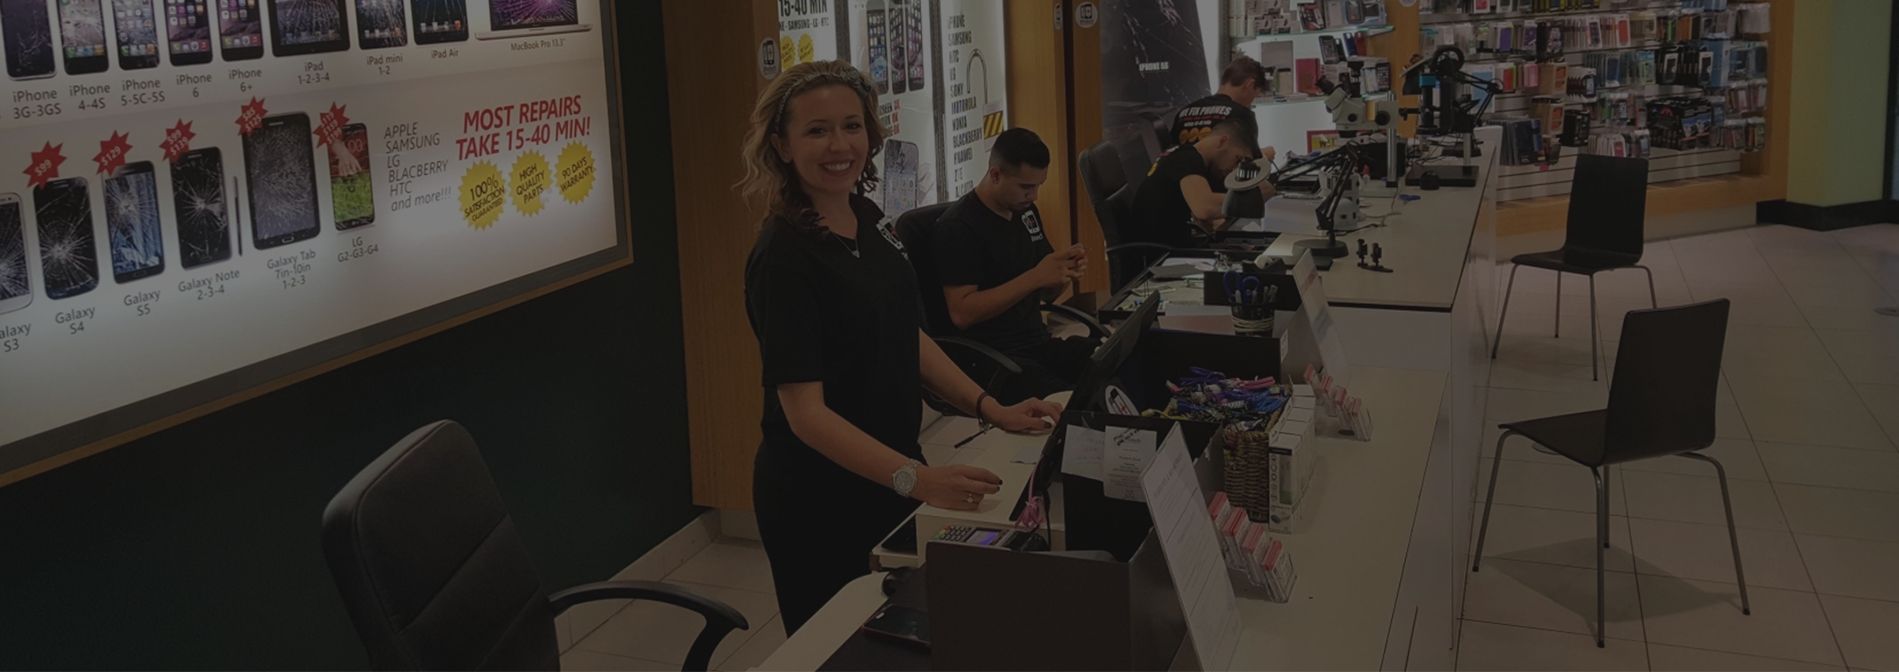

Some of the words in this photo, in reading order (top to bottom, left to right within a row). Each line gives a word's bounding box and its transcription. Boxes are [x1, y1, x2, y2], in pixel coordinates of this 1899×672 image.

[511, 40, 538, 51] MacBook
[540, 39, 551, 49] Pro
[366, 55, 385, 66] iPad
[386, 53, 403, 65] mini
[431, 50, 447, 60] iPad
[448, 49, 459, 59] Air
[228, 68, 262, 80] iPhone
[305, 60, 324, 73] iPad
[378, 65, 391, 76] 1-2
[122, 78, 161, 91] iPhone
[176, 73, 212, 86] iPhone
[297, 72, 330, 84] 1-2-3-4
[69, 82, 111, 97] iPhone
[193, 86, 200, 98] 6
[240, 81, 253, 93] 6+
[12, 89, 57, 103] iPhone
[78, 98, 106, 111] 4-4S
[121, 91, 165, 106] 5-5C-5S
[13, 102, 62, 119] 3G-3GS
[464, 105, 515, 133] MOST
[519, 94, 582, 124] REPAIRS
[384, 122, 418, 139] APPLE
[456, 131, 501, 161] TAKE
[506, 124, 550, 152] 15-40
[555, 116, 591, 143] MIN!
[386, 132, 441, 154] SAMSUNG
[101, 145, 121, 166] $129
[387, 154, 400, 169] LG
[34, 159, 52, 178] $99
[388, 160, 449, 183] BLACBERRY
[519, 163, 537, 181] HIGH
[573, 157, 588, 174] DAYS
[515, 171, 545, 196] QUALITY
[560, 164, 594, 193] WARRANTY
[390, 180, 412, 197] HTC
[469, 174, 499, 201] 100%
[523, 185, 544, 205] PARTS
[391, 198, 411, 212] and
[414, 186, 451, 206] more!!!
[463, 184, 505, 217] SATISFACTION
[351, 236, 363, 248] LG
[266, 255, 297, 271] Galaxy
[299, 248, 316, 262] Tab
[337, 244, 379, 263] G2-G3-G4
[178, 274, 212, 293] Galaxy
[215, 268, 240, 284] Note
[282, 275, 306, 290] 1-2-3
[123, 289, 161, 307] Galaxy
[197, 284, 225, 300] 2-3-4
[55, 306, 95, 324] Galaxy
[136, 303, 151, 317] S5
[0, 322, 31, 341] alaxy
[70, 321, 85, 335] S4
[3, 338, 19, 352] S3
